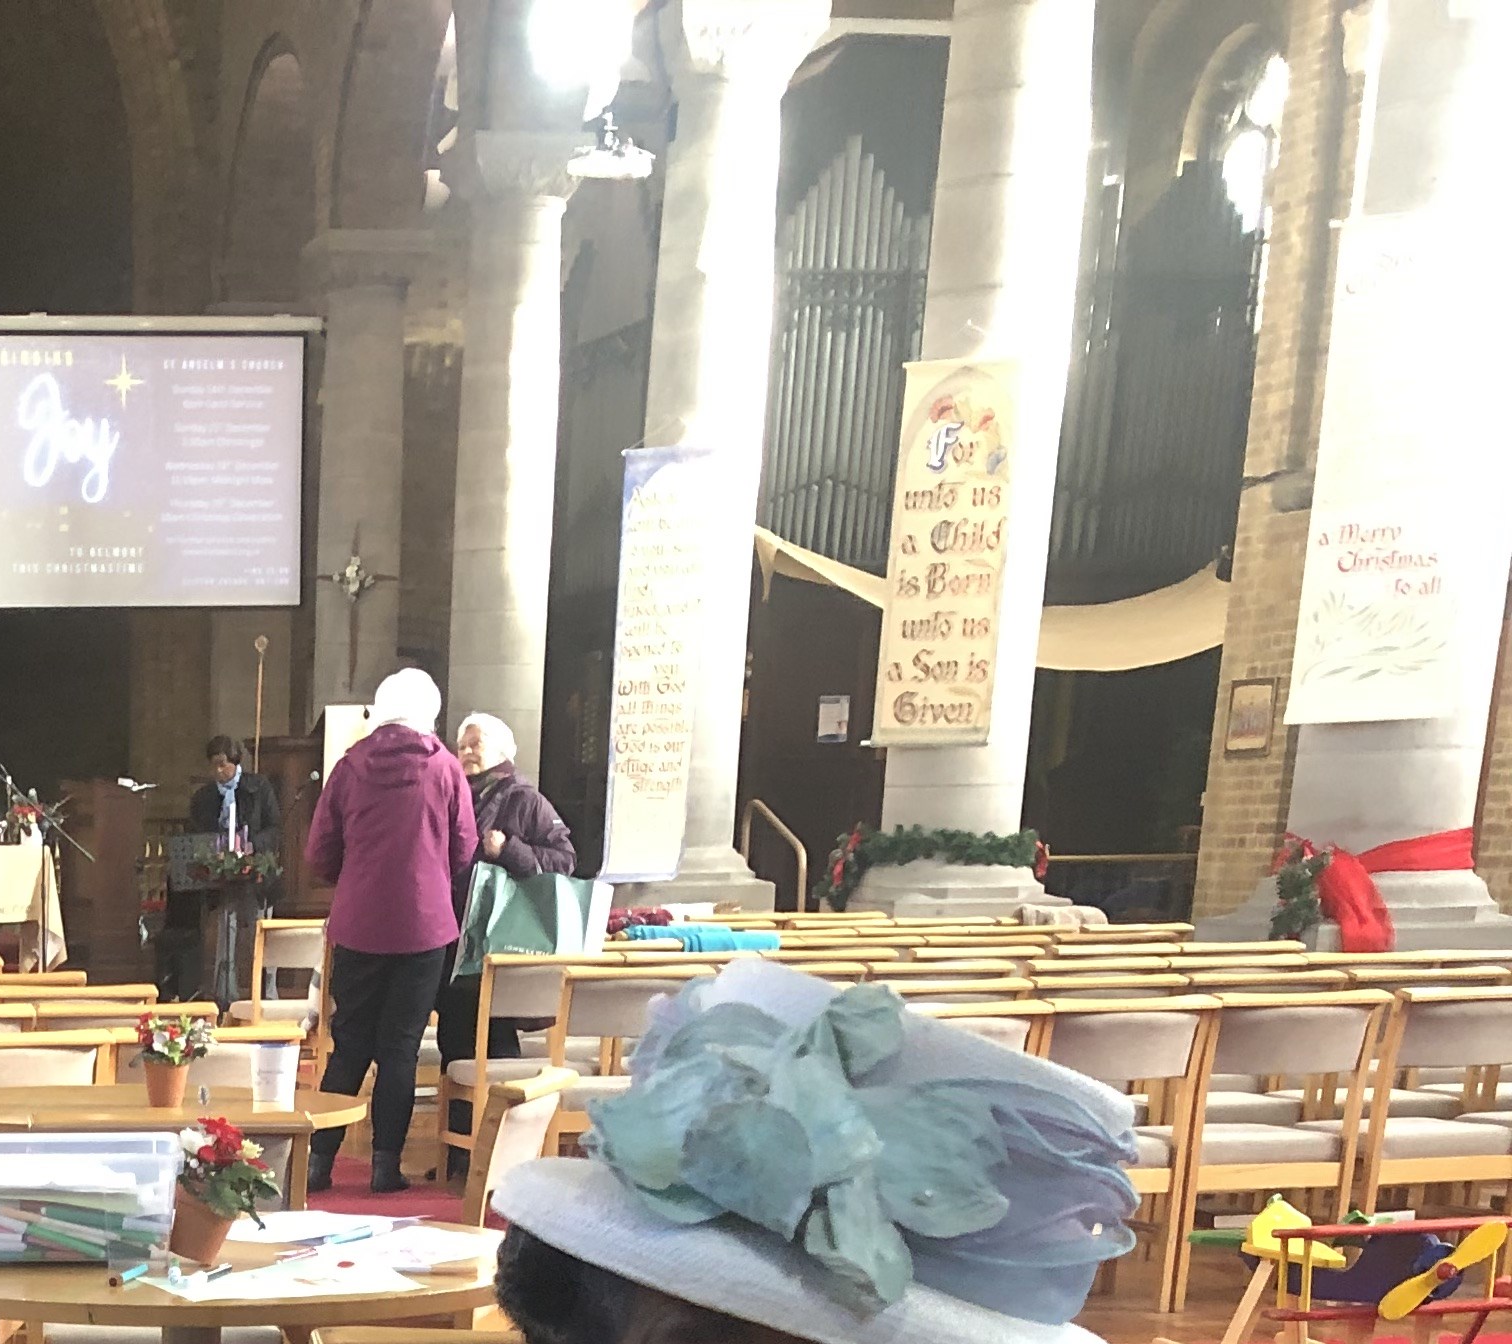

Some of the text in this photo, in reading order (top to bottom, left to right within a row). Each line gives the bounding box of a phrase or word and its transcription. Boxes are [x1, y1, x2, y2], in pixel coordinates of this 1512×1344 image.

[181, 359, 236, 370] ANSELMS
[18, 372, 120, 503] Joy
[926, 420, 980, 474] For
[904, 480, 1001, 511] unto us
[901, 516, 1007, 555] a Child
[1338, 523, 1402, 545] Merry
[1337, 547, 1439, 573] Christmas
[896, 562, 991, 599] is Born
[1419, 575, 1442, 595] all
[901, 610, 990, 640] unto us
[887, 648, 990, 683] a Son is
[893, 690, 974, 726] Given
